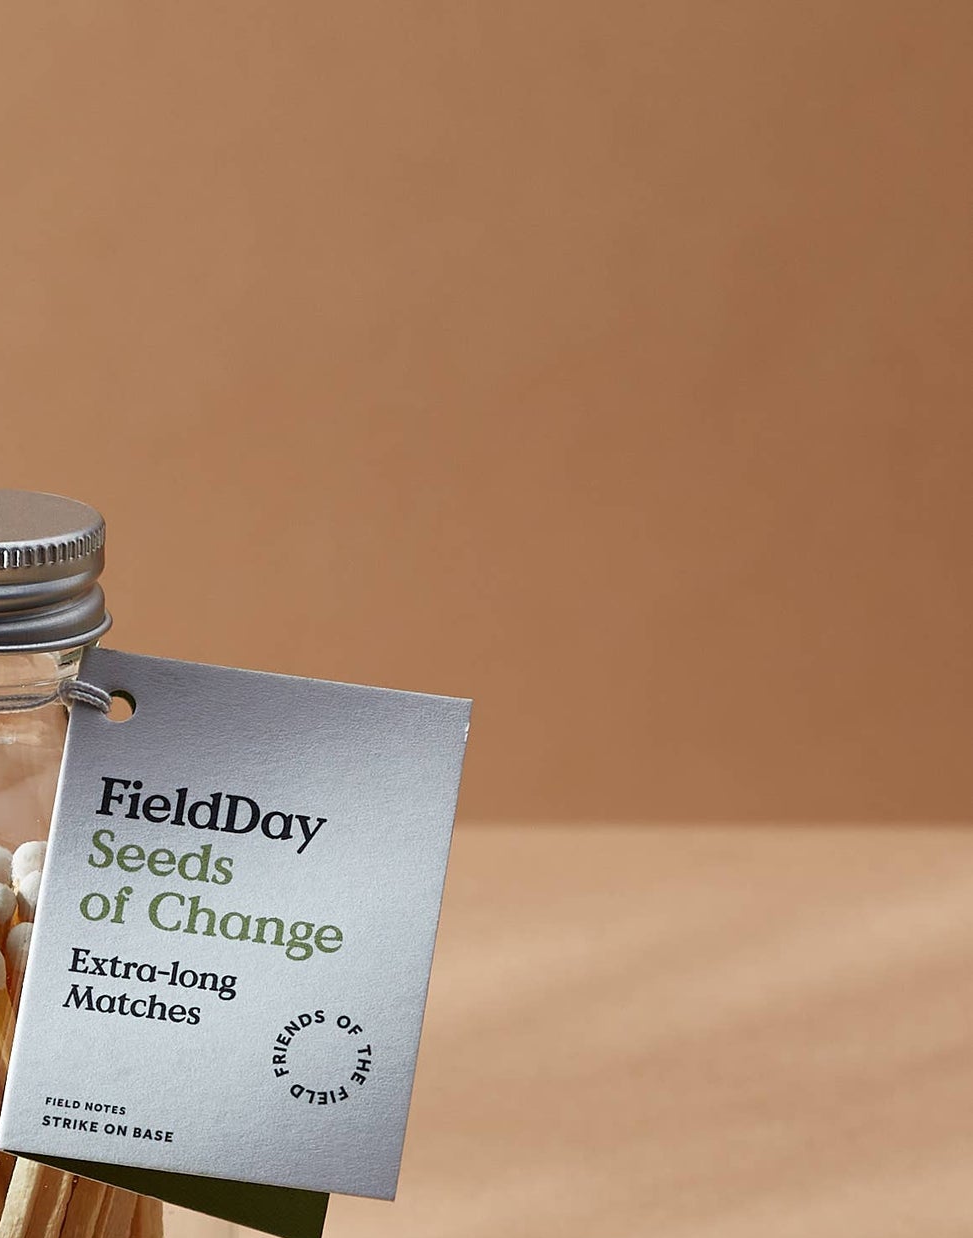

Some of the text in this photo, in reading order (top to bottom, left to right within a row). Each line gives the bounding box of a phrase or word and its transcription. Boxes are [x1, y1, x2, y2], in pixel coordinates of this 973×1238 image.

[95, 776, 328, 855] FieldDay
[87, 828, 234, 886] Seeds
[79, 885, 344, 962] of Change
[67, 947, 239, 1001] Extra-long
[61, 983, 201, 1026] Matches
[271, 1009, 373, 1106] FRIENDS OF THE FIELD
[41, 1114, 175, 1143] STRIKE ON BASE
[44, 1096, 127, 1116] FIELD NOTES
